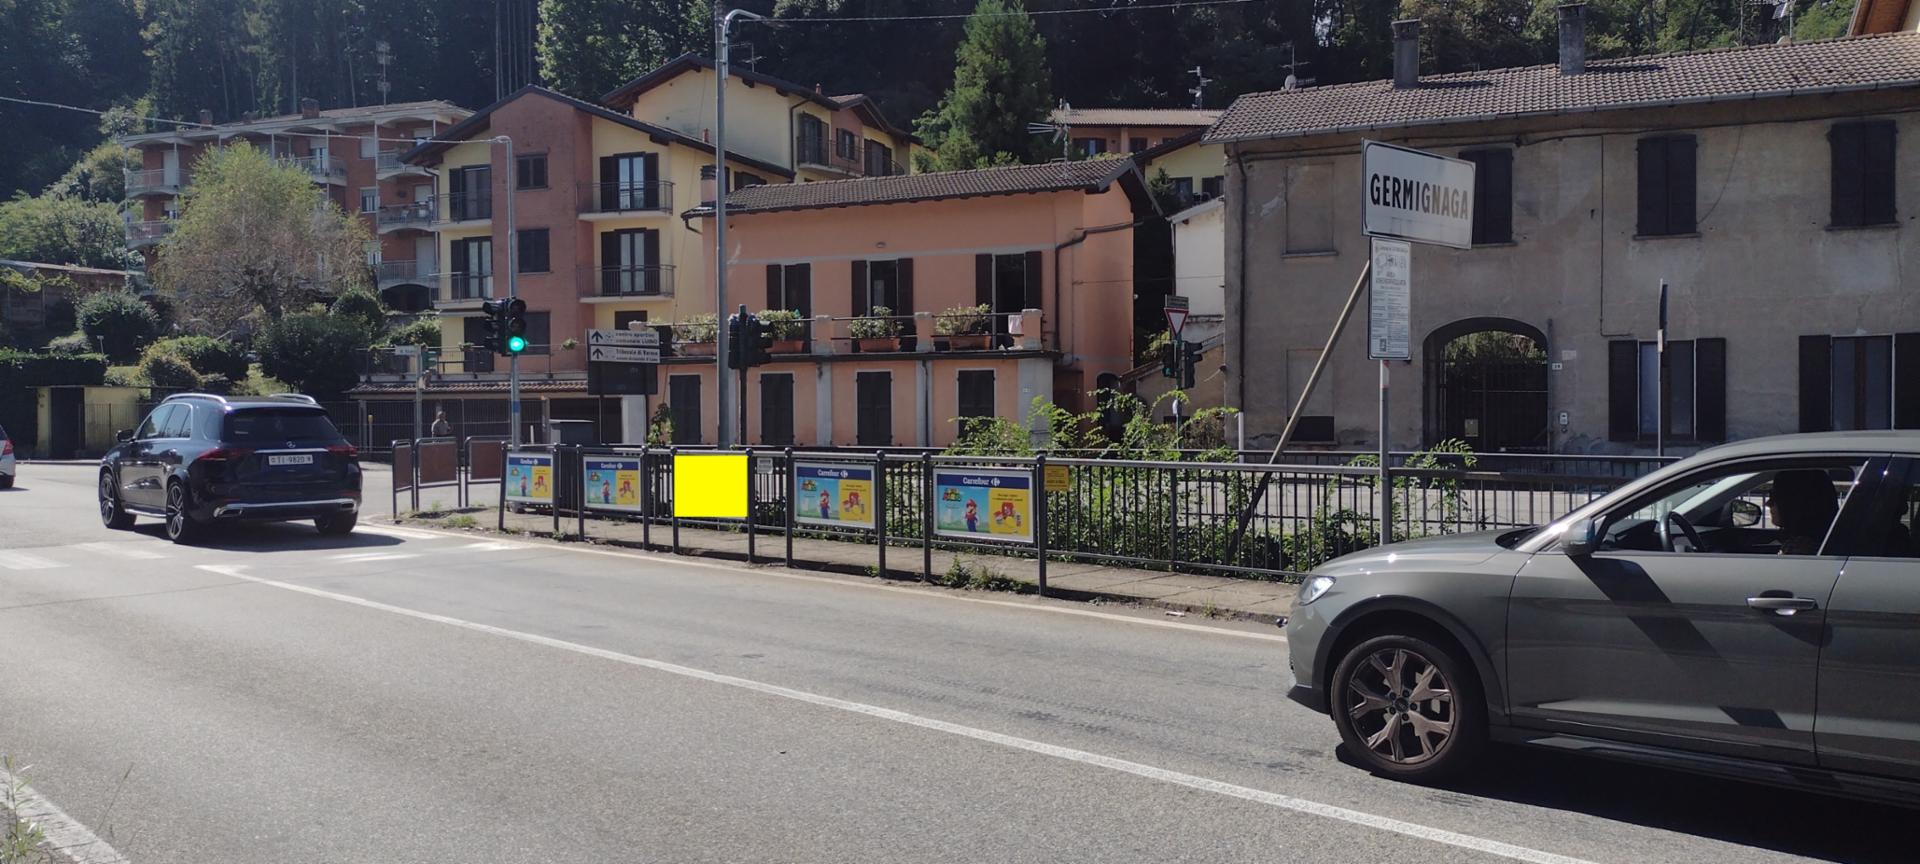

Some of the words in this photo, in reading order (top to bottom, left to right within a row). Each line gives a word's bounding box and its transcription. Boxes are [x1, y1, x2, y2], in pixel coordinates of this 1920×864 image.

[1370, 173, 1468, 220] GERMIGNAGA
[817, 469, 840, 477] Carrefour
[962, 477, 989, 486] Carrefour
